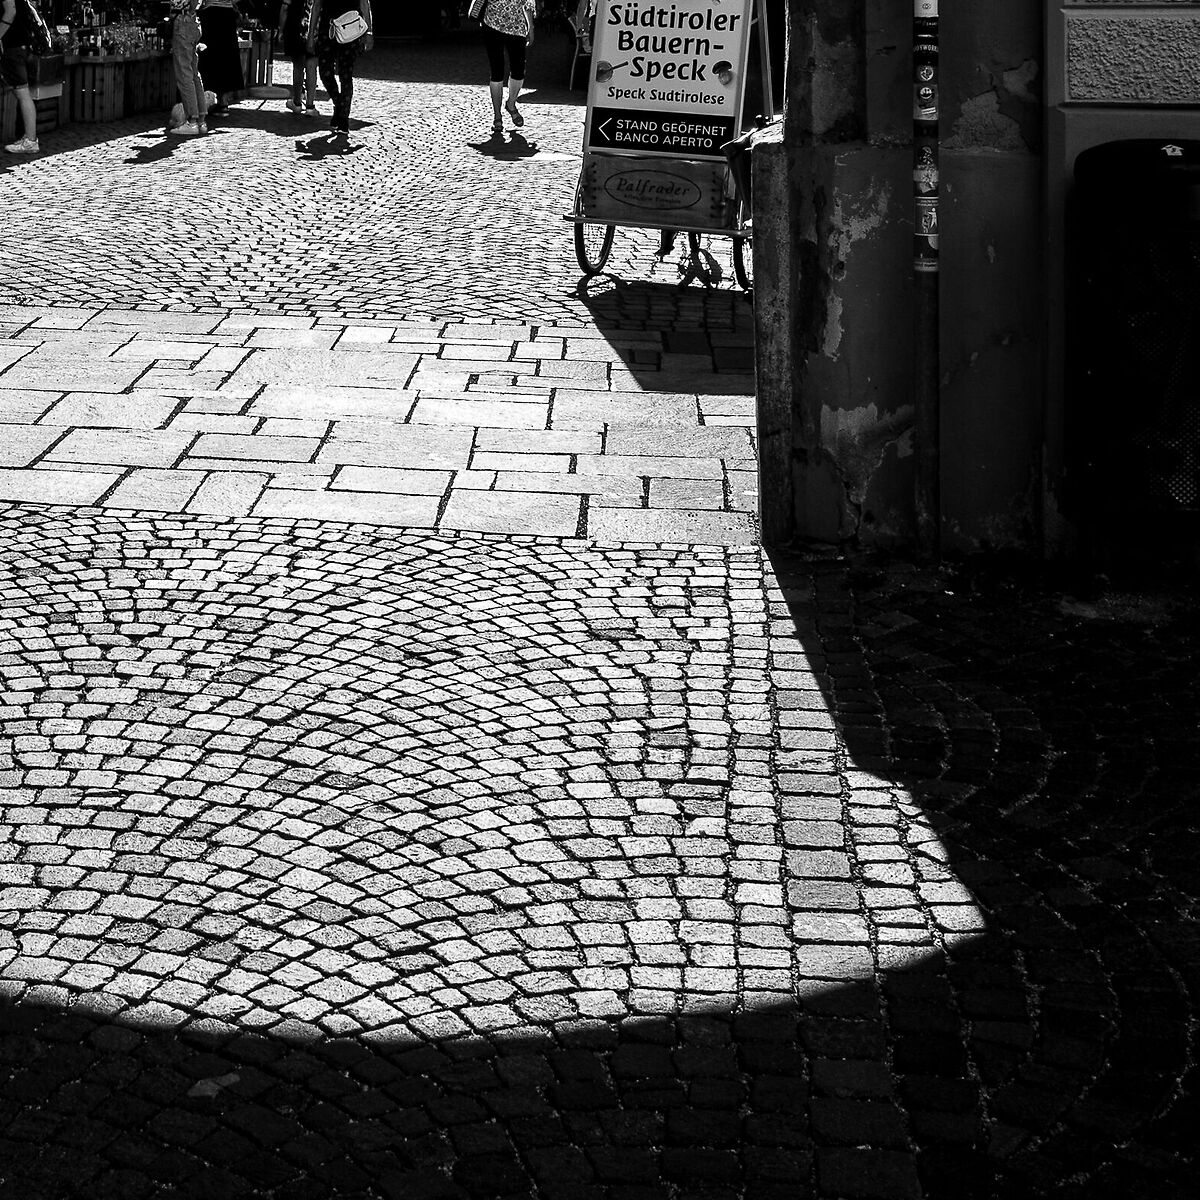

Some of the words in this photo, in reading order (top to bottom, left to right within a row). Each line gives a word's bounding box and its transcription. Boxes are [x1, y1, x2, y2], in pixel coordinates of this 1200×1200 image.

[608, 3, 741, 32] Südtiroler
[617, 29, 725, 56] Bauern-
[630, 56, 707, 83] Speck
[607, 86, 646, 100] Speck
[650, 89, 725, 105] Sudtirolese
[616, 119, 658, 131] STAND
[661, 121, 727, 137] GEÖFFNET
[615, 131, 659, 144] BANCO
[663, 134, 713, 148] APERTO
[616, 178, 690, 196] Palfrader
